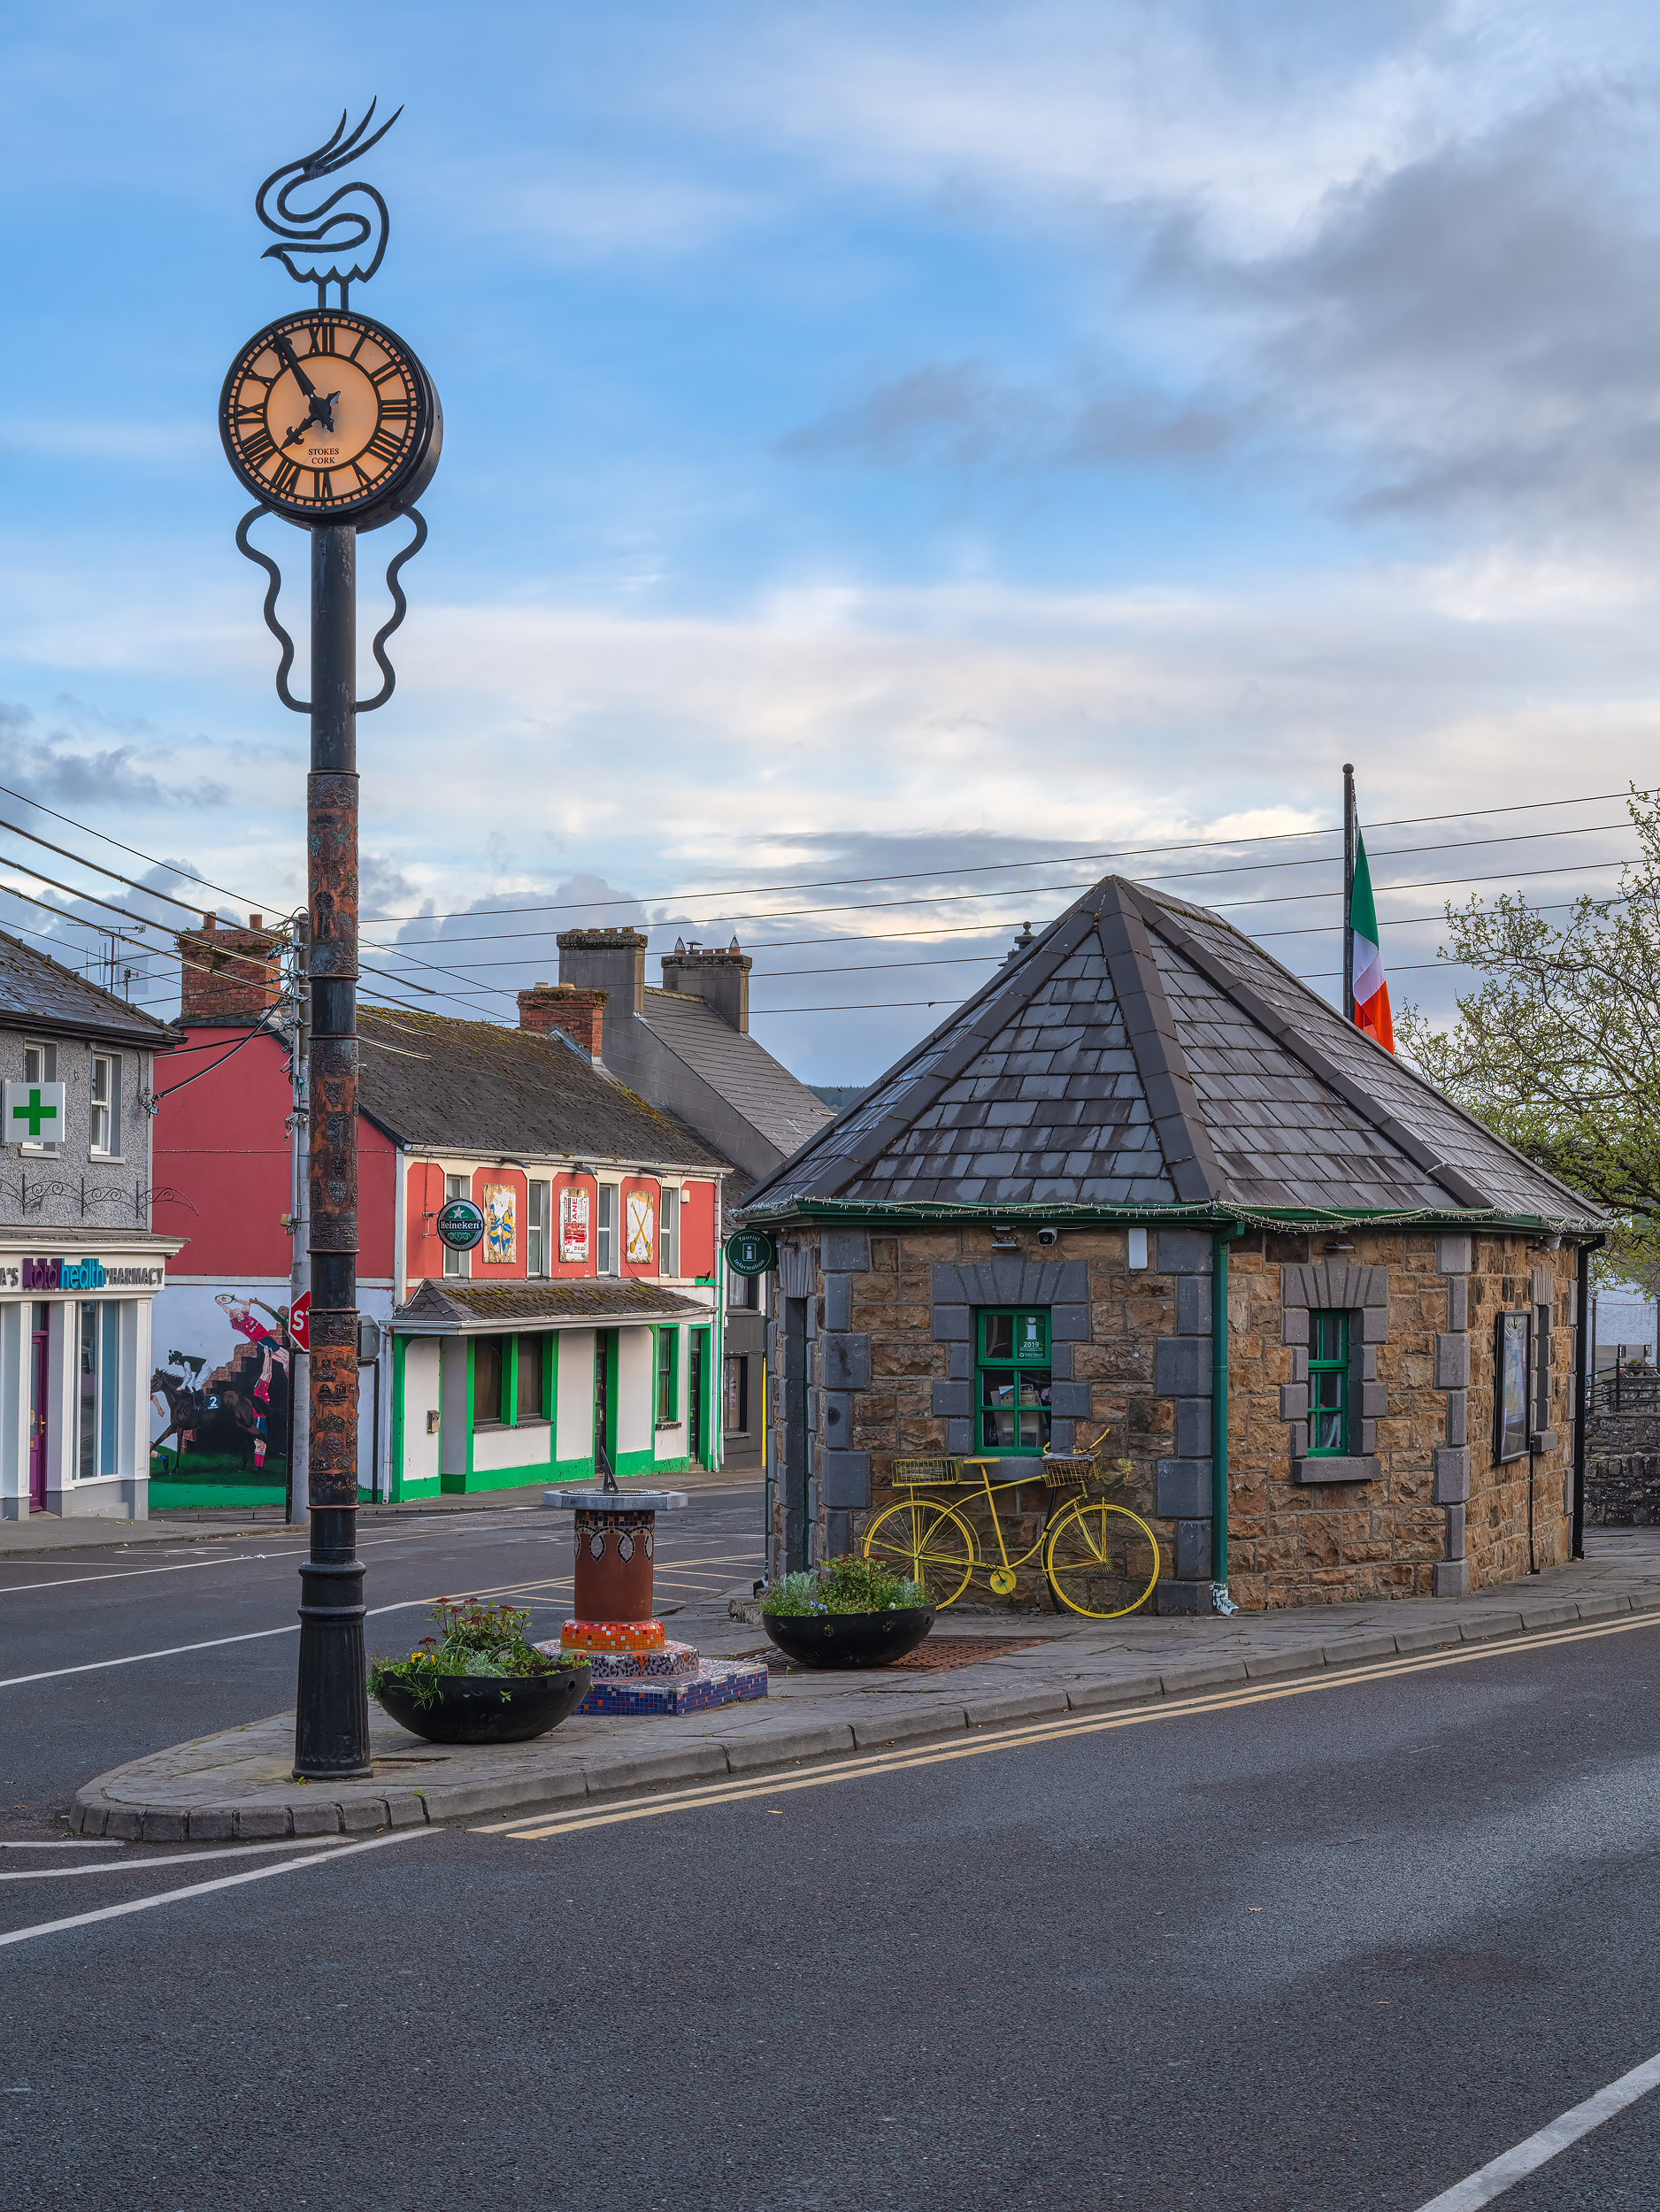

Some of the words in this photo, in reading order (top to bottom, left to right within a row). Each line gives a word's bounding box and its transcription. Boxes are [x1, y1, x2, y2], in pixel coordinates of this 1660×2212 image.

[309, 326, 335, 354] XII
[441, 1221, 480, 1230] Heineken
[734, 1258, 765, 1271] Information
[104, 1267, 164, 1285] PHARMACY
[210, 1396, 218, 1406] 2
